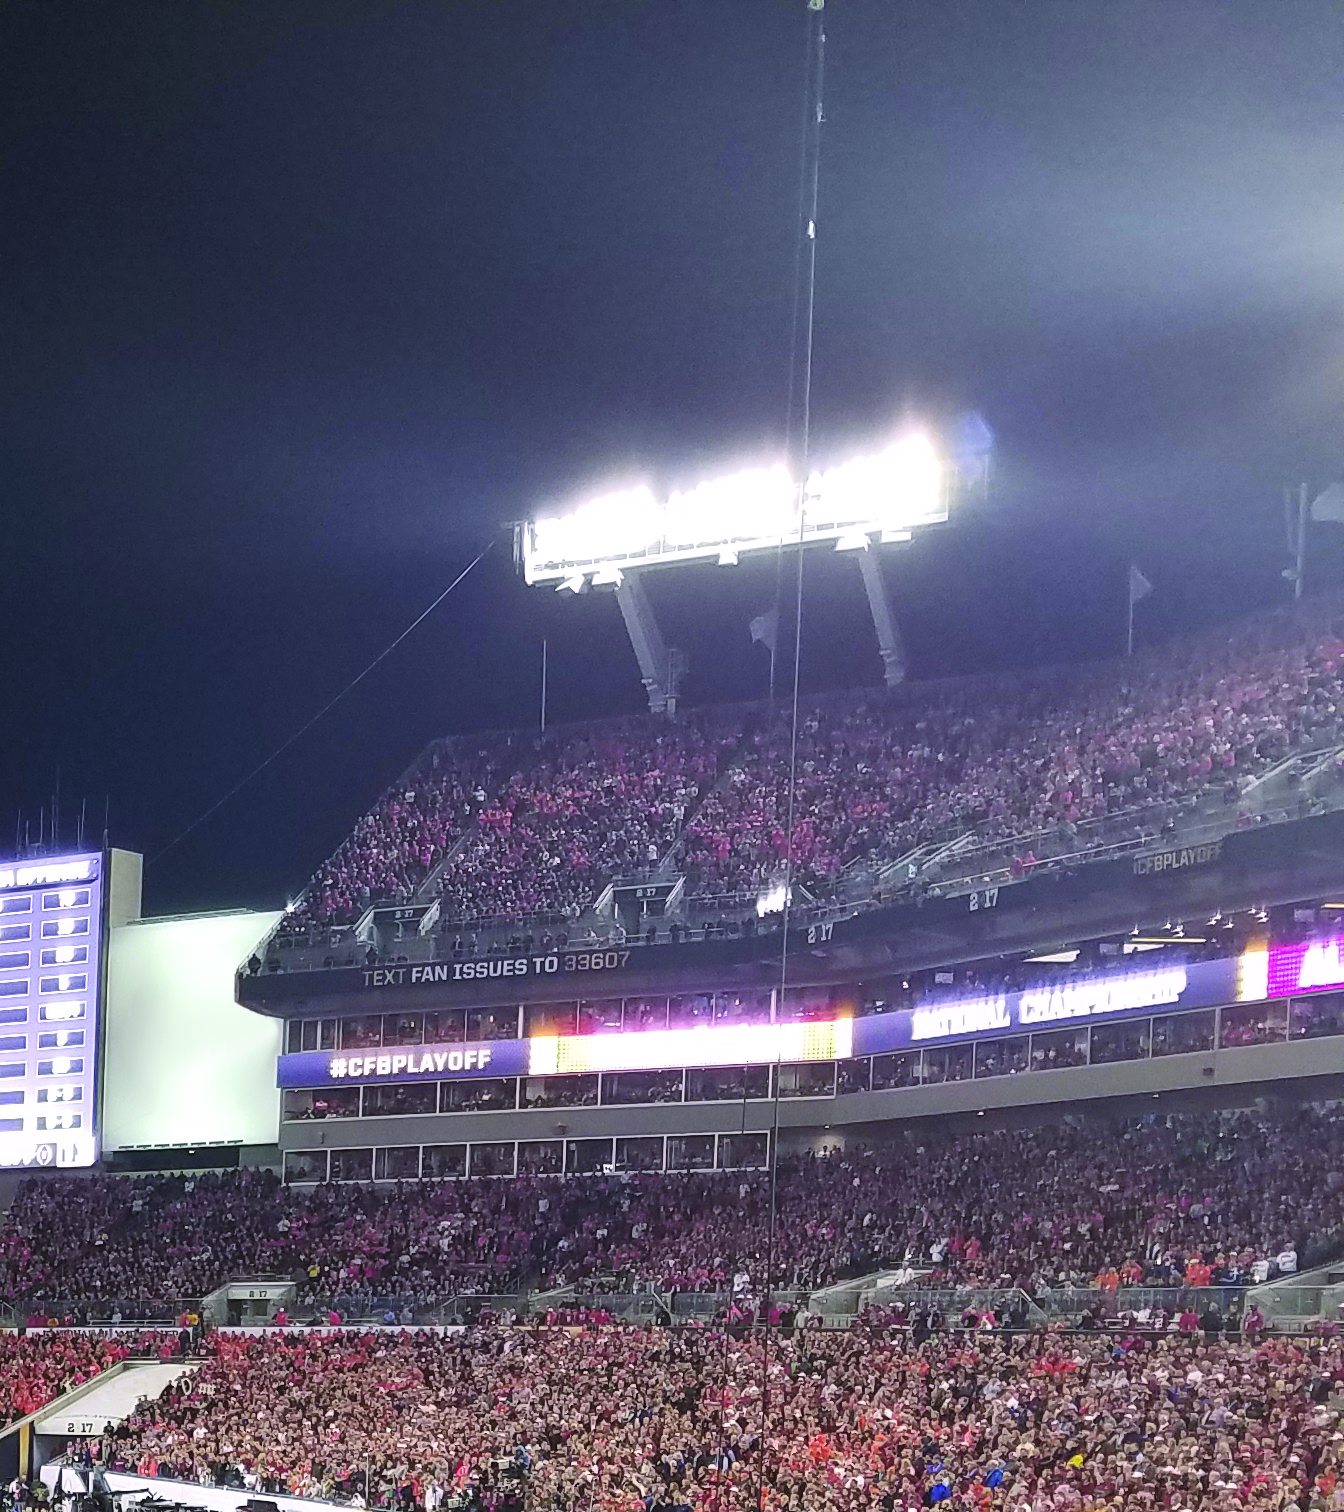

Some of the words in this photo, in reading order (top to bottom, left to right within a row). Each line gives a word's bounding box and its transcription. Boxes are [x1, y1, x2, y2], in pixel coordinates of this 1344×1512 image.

[363, 968, 407, 986] TEXT
[412, 963, 448, 983] FAN
[453, 958, 528, 981] ISSUES
[532, 956, 558, 974] TO
[565, 951, 630, 971] 33607
[329, 1049, 492, 1079] #CFBPLAYOFF
